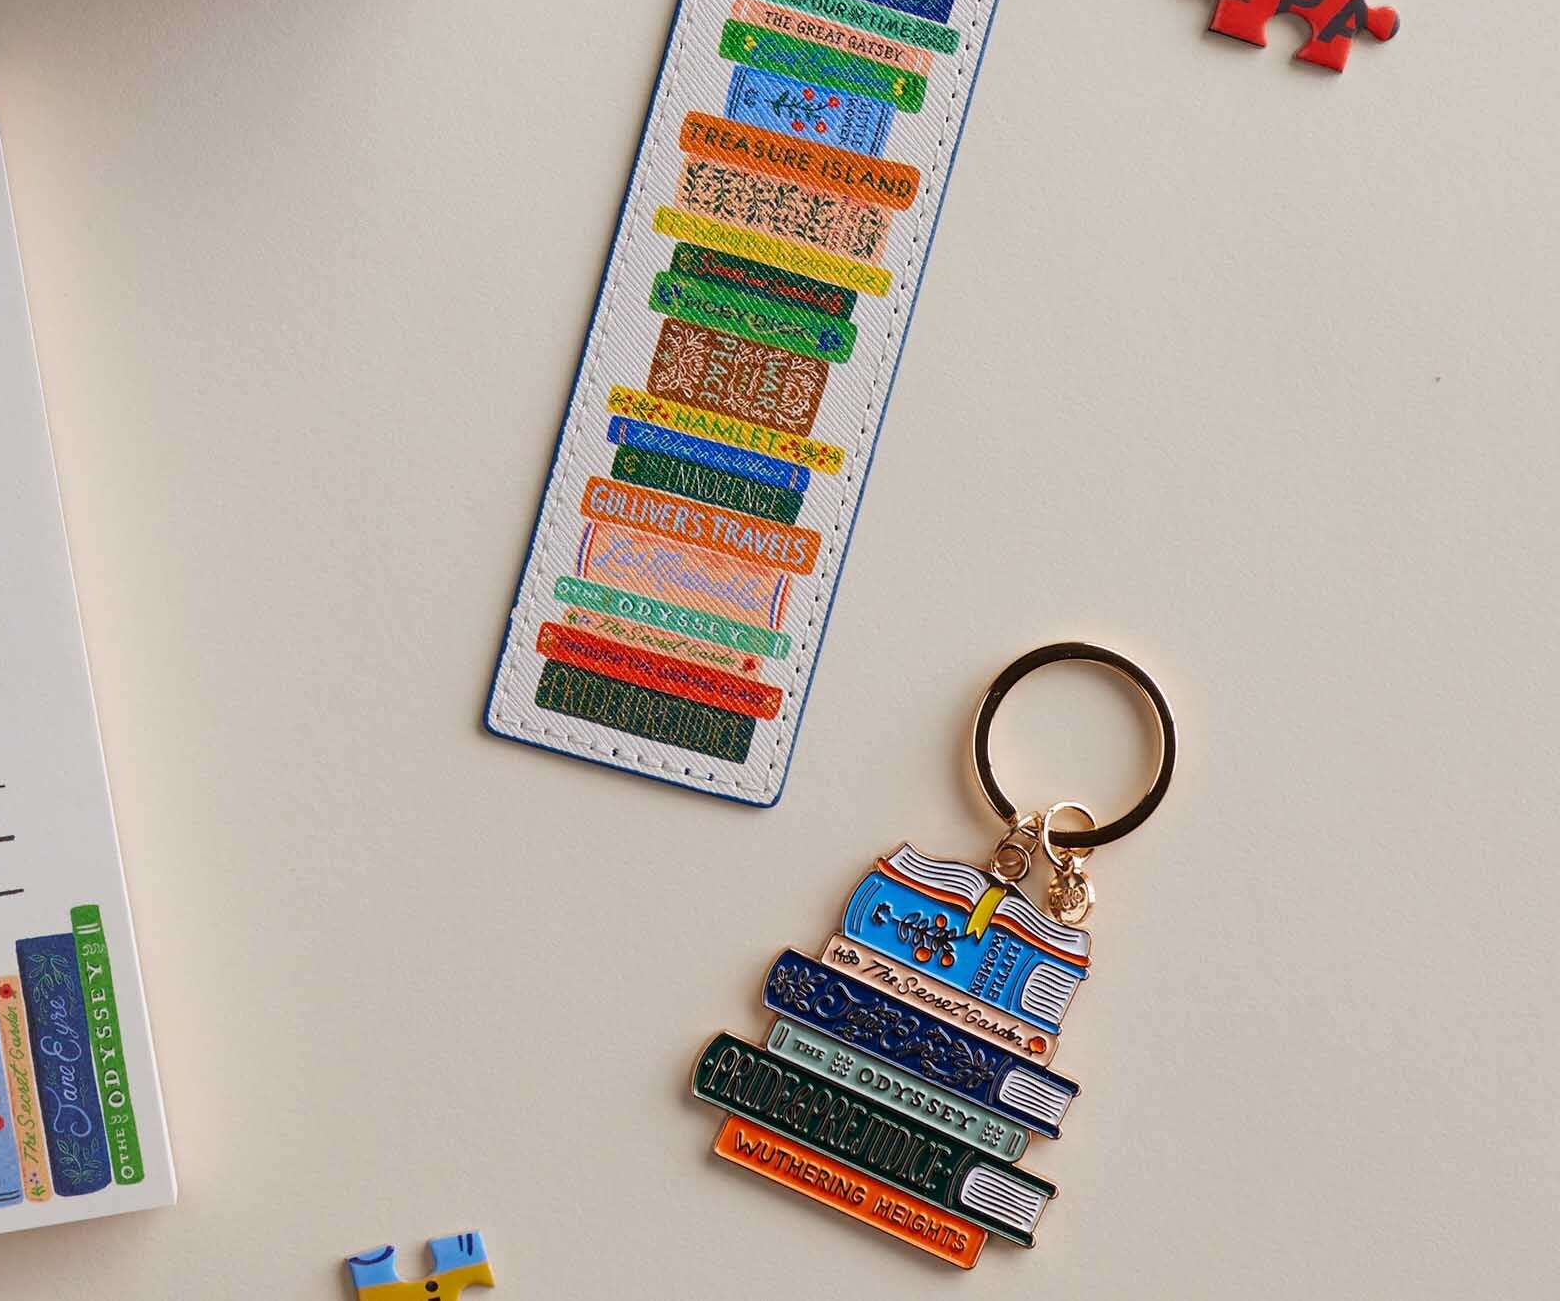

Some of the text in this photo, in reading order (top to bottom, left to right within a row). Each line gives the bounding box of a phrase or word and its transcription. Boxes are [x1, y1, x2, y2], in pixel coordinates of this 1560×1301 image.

[764, 10, 903, 62] THE GREAT GATSBY
[868, 11, 913, 39] TIME
[689, 122, 913, 198] TREASURE ISLAND
[684, 296, 745, 322] MOBY
[699, 336, 739, 405] PEACE
[756, 359, 787, 411] WAR
[674, 409, 781, 450] HAMLET
[664, 460, 788, 517] INNOCENCE
[591, 485, 808, 566] GULLIVER'S TRAVELS
[618, 598, 746, 642] ODYSSEY
[860, 959, 896, 986] The
[897, 974, 963, 1018] Secret
[970, 932, 1007, 998] WOMEN
[989, 940, 1022, 1002] LITTLE
[40, 996, 93, 1139] Jane Eyre
[86, 960, 130, 1163] THE ODYSSEY
[793, 1039, 977, 1131] THE ODYSSEY
[10, 1063, 38, 1133] Secret
[23, 1133, 40, 1164] The
[733, 1130, 970, 1252] WUTHERING HEIGHTS
